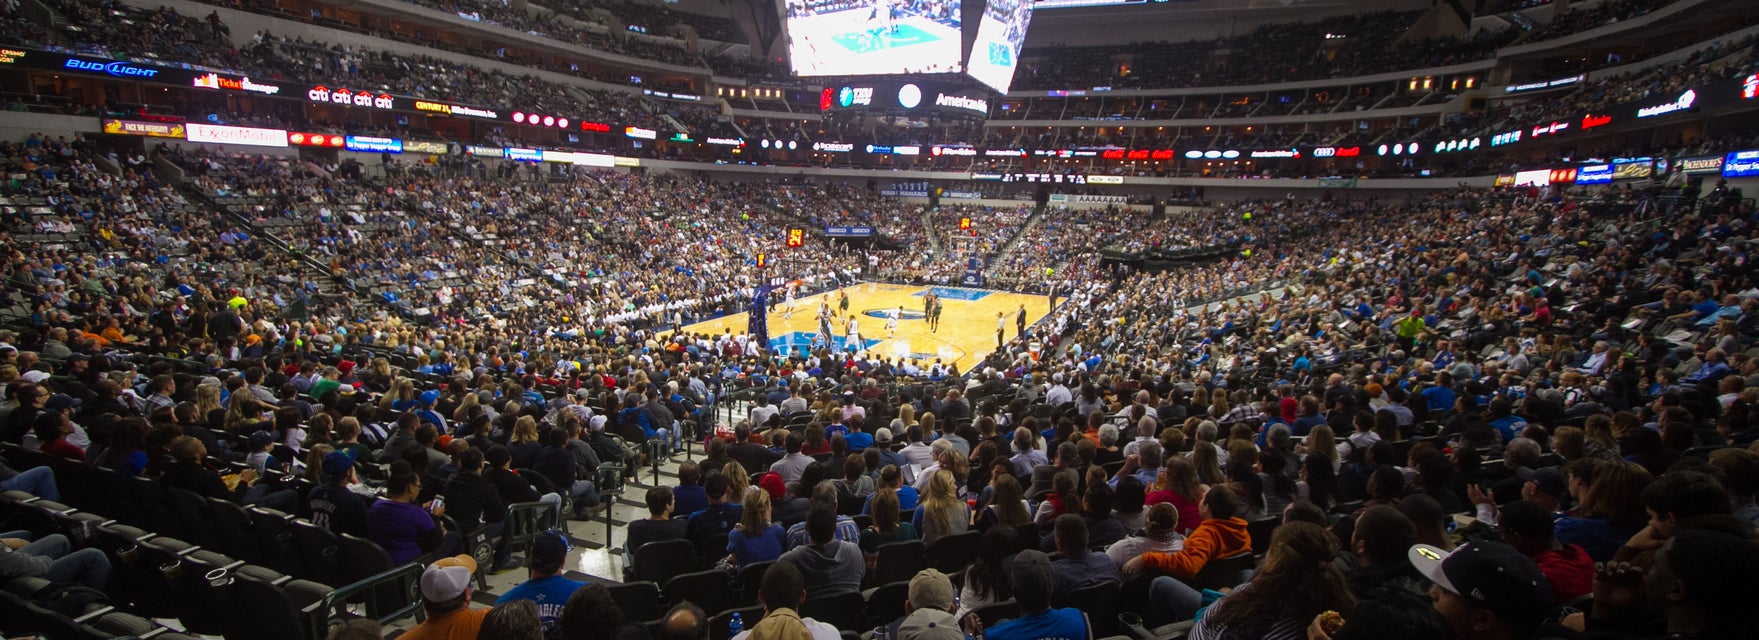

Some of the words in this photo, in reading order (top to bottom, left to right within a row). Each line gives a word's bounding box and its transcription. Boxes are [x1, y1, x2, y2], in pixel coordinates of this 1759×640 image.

[65, 59, 104, 71] BUD
[112, 64, 158, 77] LIGHT
[199, 126, 275, 141] ExxonMobil
[1336, 147, 1360, 157] Audi
